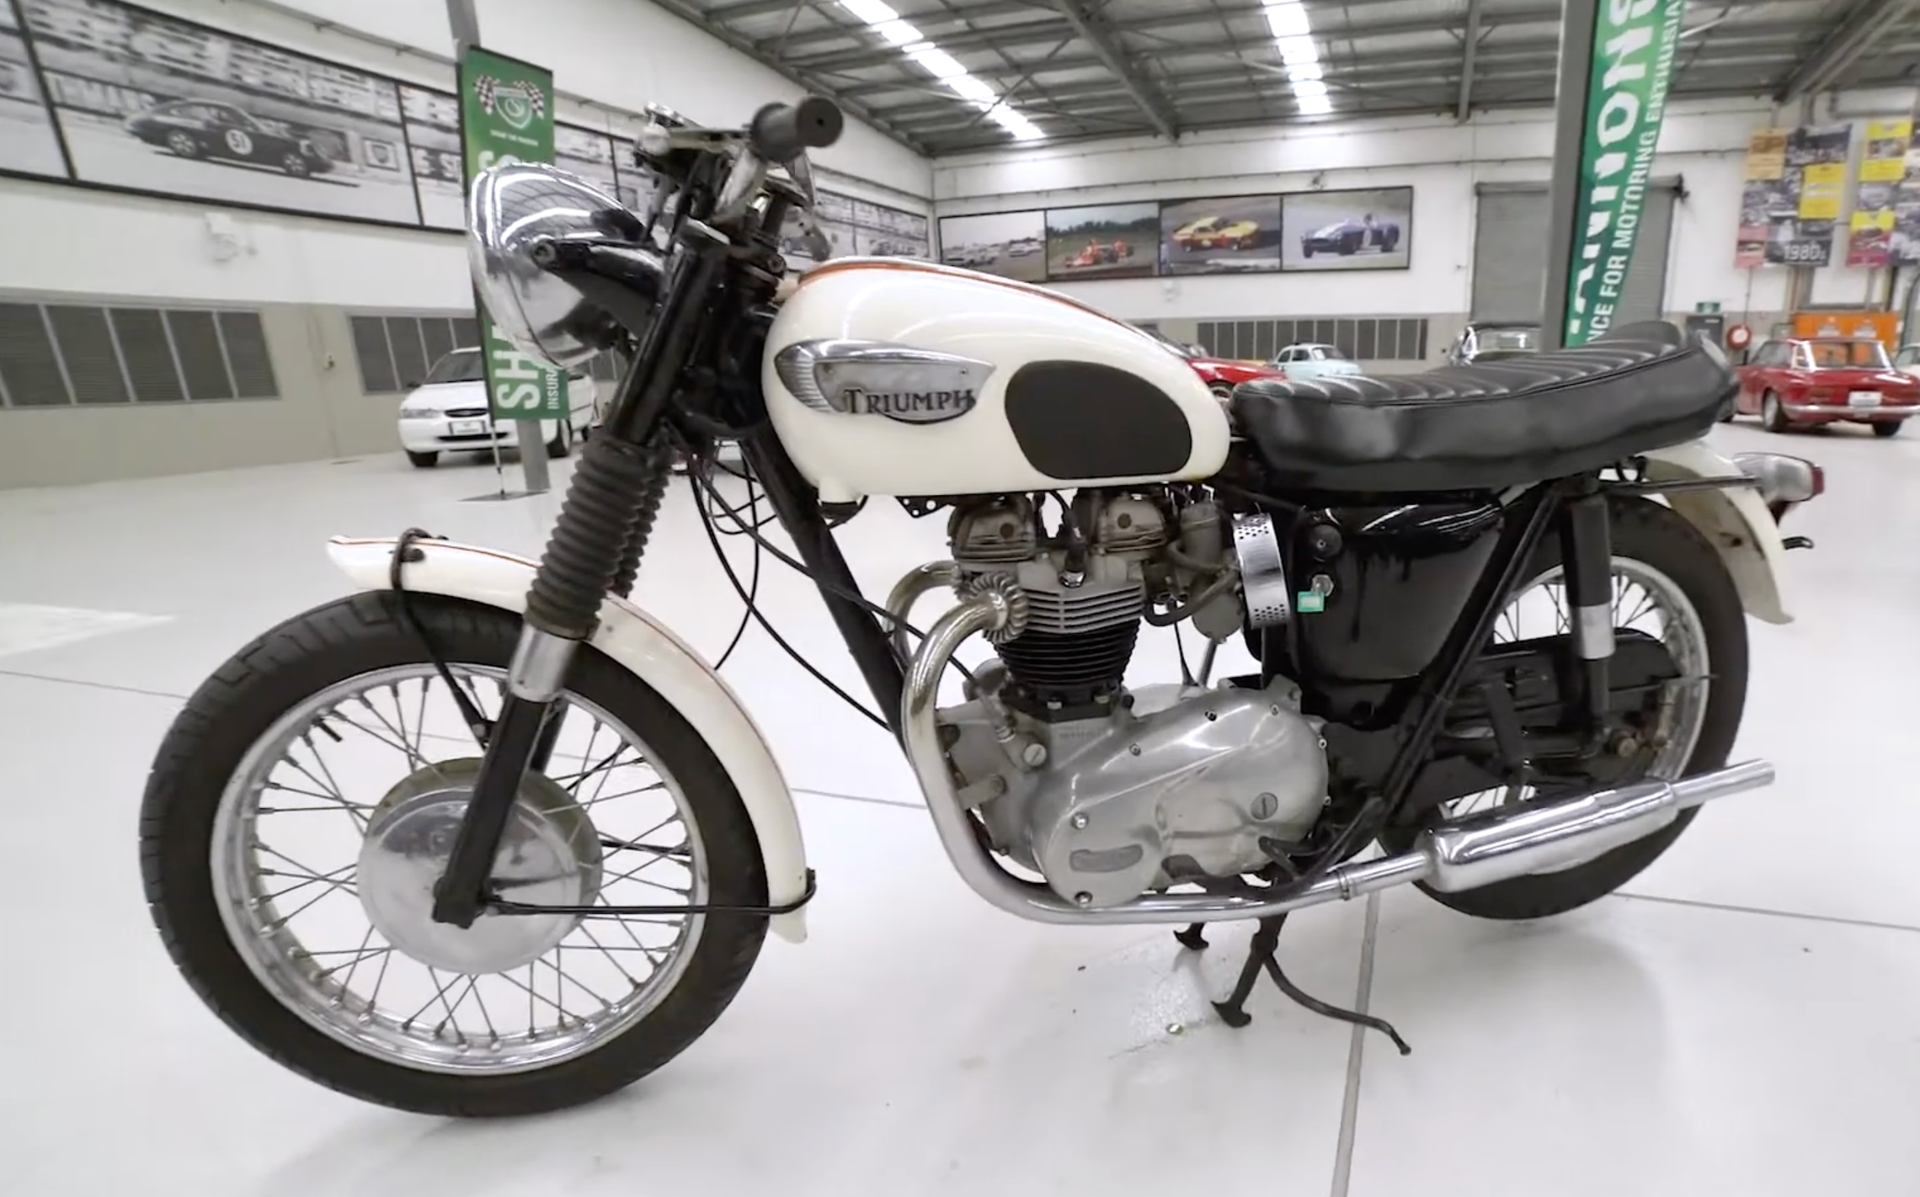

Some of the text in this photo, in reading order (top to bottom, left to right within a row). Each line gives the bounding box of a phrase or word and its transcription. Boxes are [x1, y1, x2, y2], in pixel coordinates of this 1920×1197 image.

[1586, 0, 1682, 342] NCE FOR MOTORING ENTHUSIA
[844, 388, 975, 414] TRIUMPH
